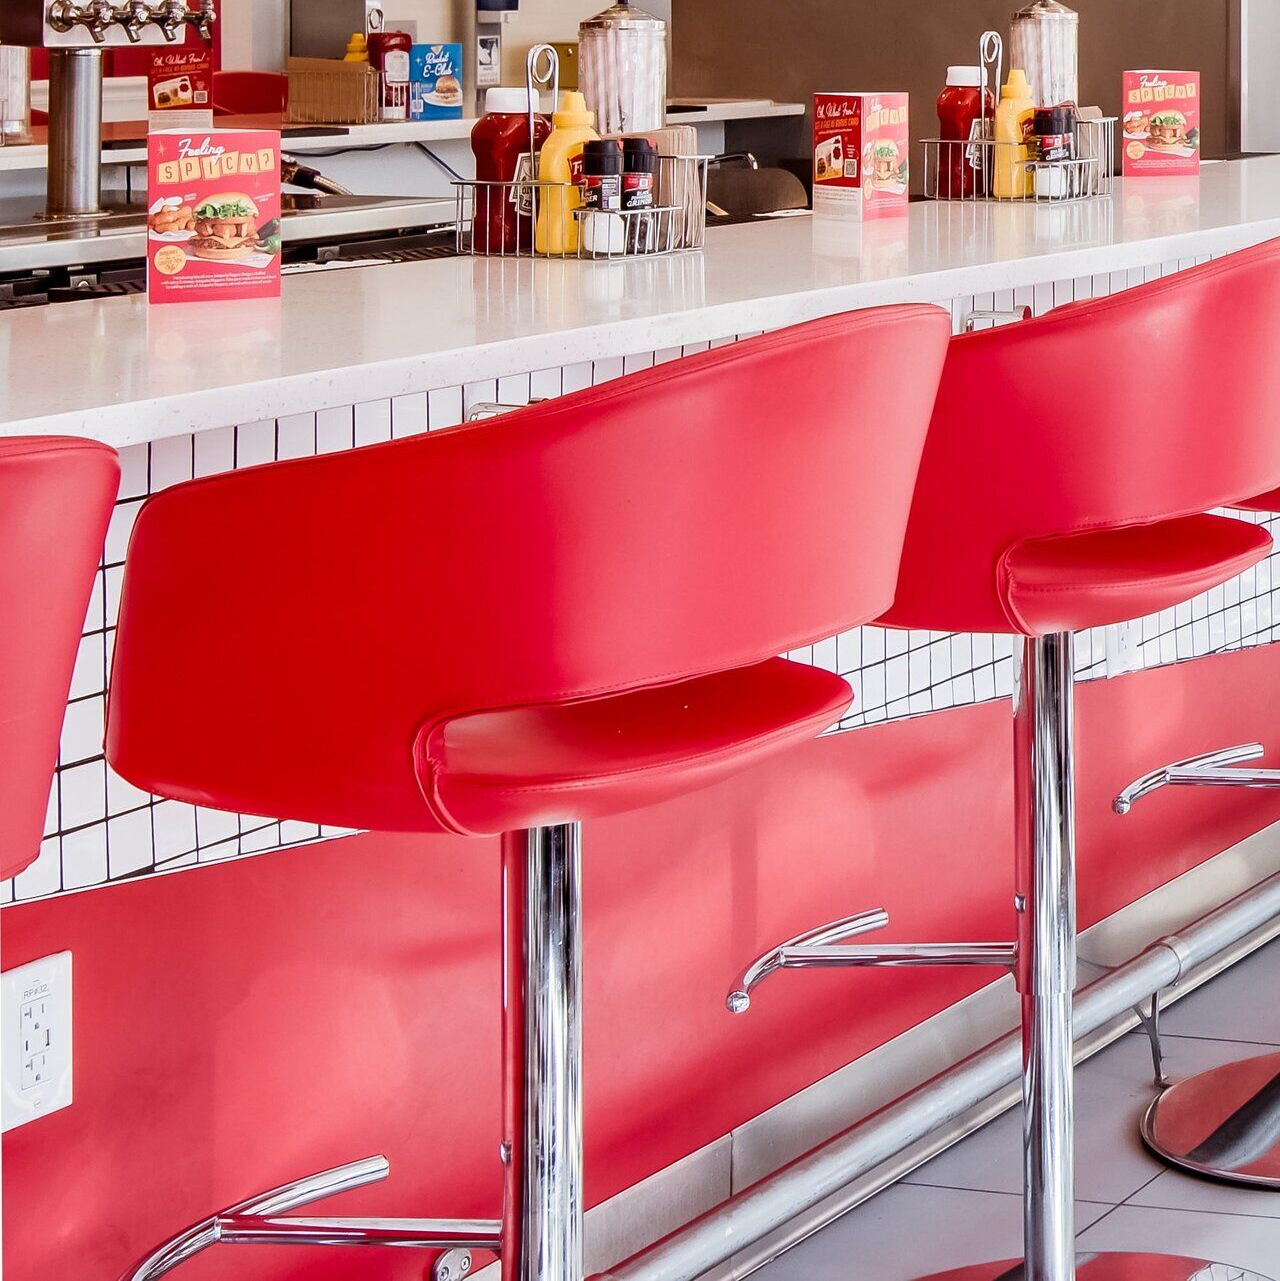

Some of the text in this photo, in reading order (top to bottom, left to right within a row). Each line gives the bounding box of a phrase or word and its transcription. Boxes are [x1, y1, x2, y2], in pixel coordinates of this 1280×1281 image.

[165, 54, 187, 64] What
[423, 62, 452, 77] E-Club
[178, 137, 225, 165] Feeling
[164, 152, 270, 180] SPICY?
